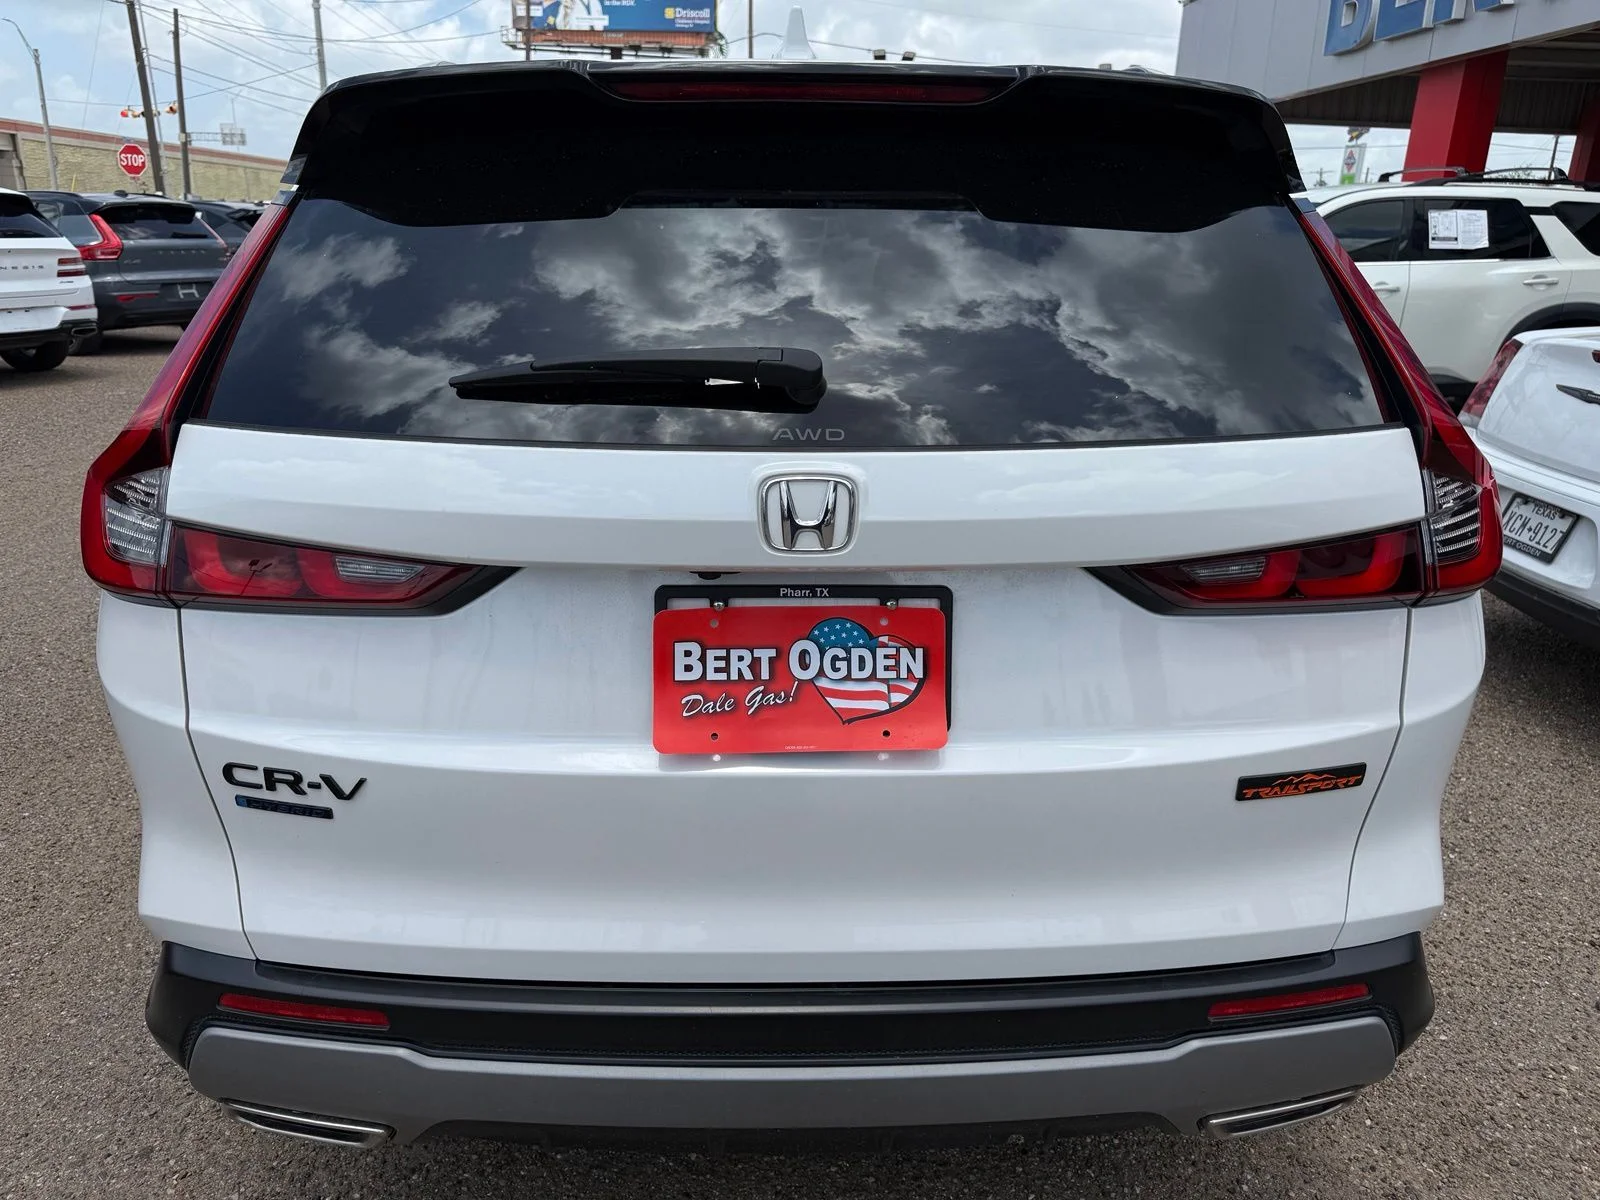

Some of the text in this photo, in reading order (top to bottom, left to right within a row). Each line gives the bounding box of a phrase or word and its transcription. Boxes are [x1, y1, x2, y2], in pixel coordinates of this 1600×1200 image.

[675, 8, 710, 18] Driscoll
[120, 153, 145, 167] STOP
[772, 428, 845, 441] AWD
[1531, 503, 1559, 521] TEXAS
[1516, 542, 1542, 557] OGDEN
[780, 587, 830, 598] Pharr, TX
[673, 639, 926, 681] BERT OGDEN
[681, 681, 799, 717] Dale Gas!
[222, 761, 368, 801] CR-V
[1243, 775, 1362, 798] TRAILSPORT
